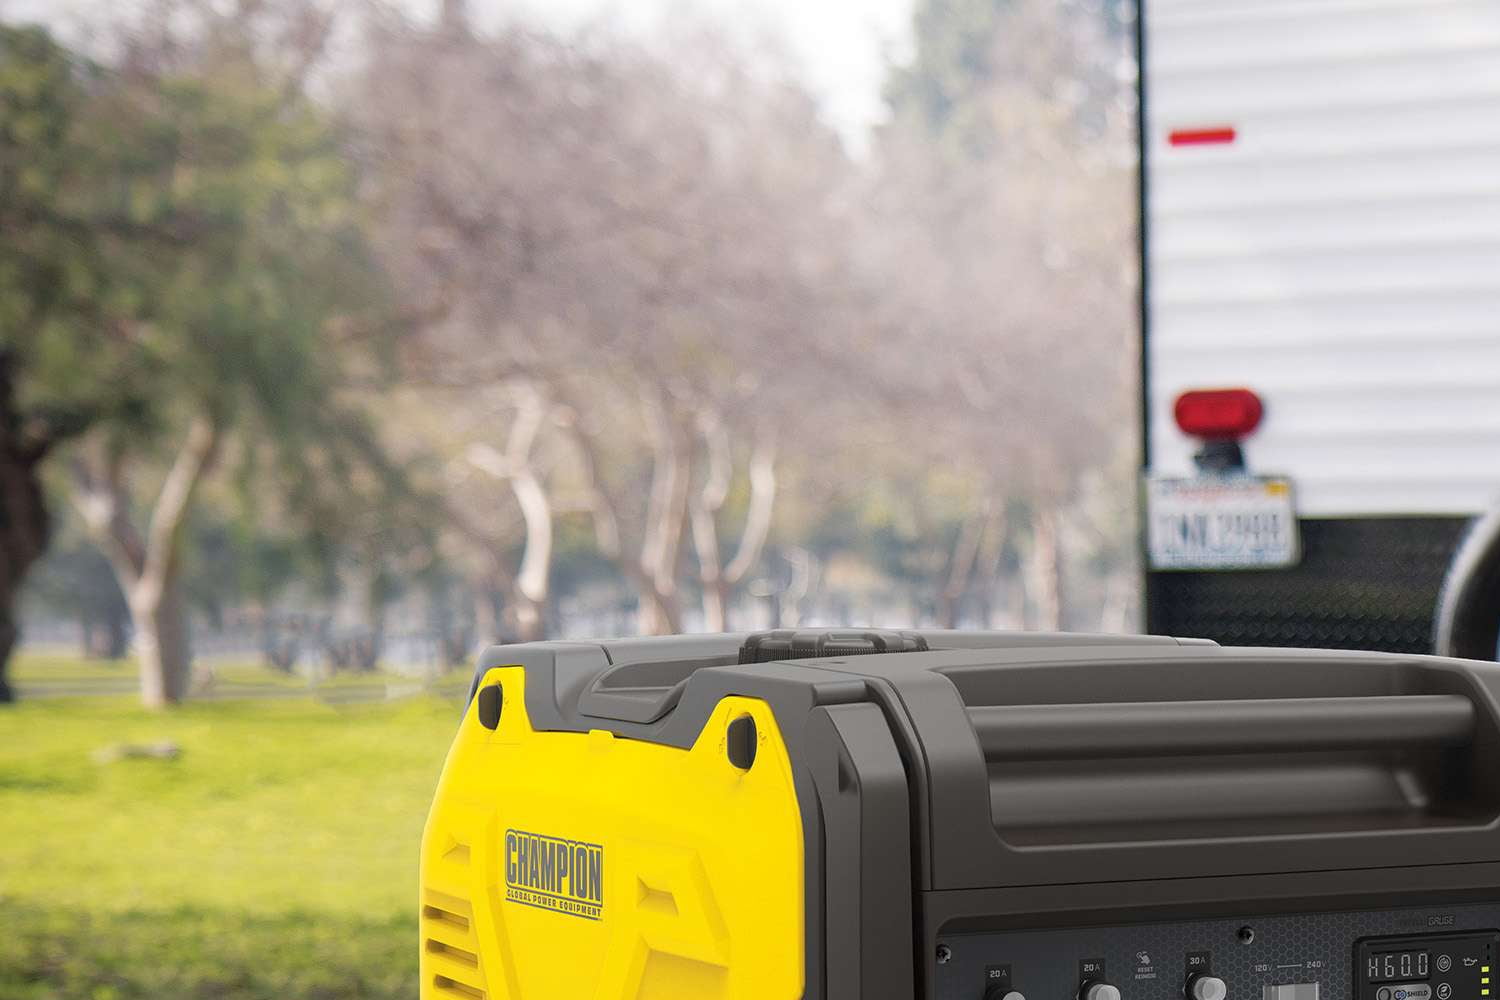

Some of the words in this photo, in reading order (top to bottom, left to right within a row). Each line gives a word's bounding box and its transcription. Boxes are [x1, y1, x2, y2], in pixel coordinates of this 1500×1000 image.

[506, 833, 601, 902] CHAMPION
[507, 888, 531, 902] GLOBAL
[533, 895, 557, 907] POWER
[560, 901, 601, 917] EQUIPMENT
